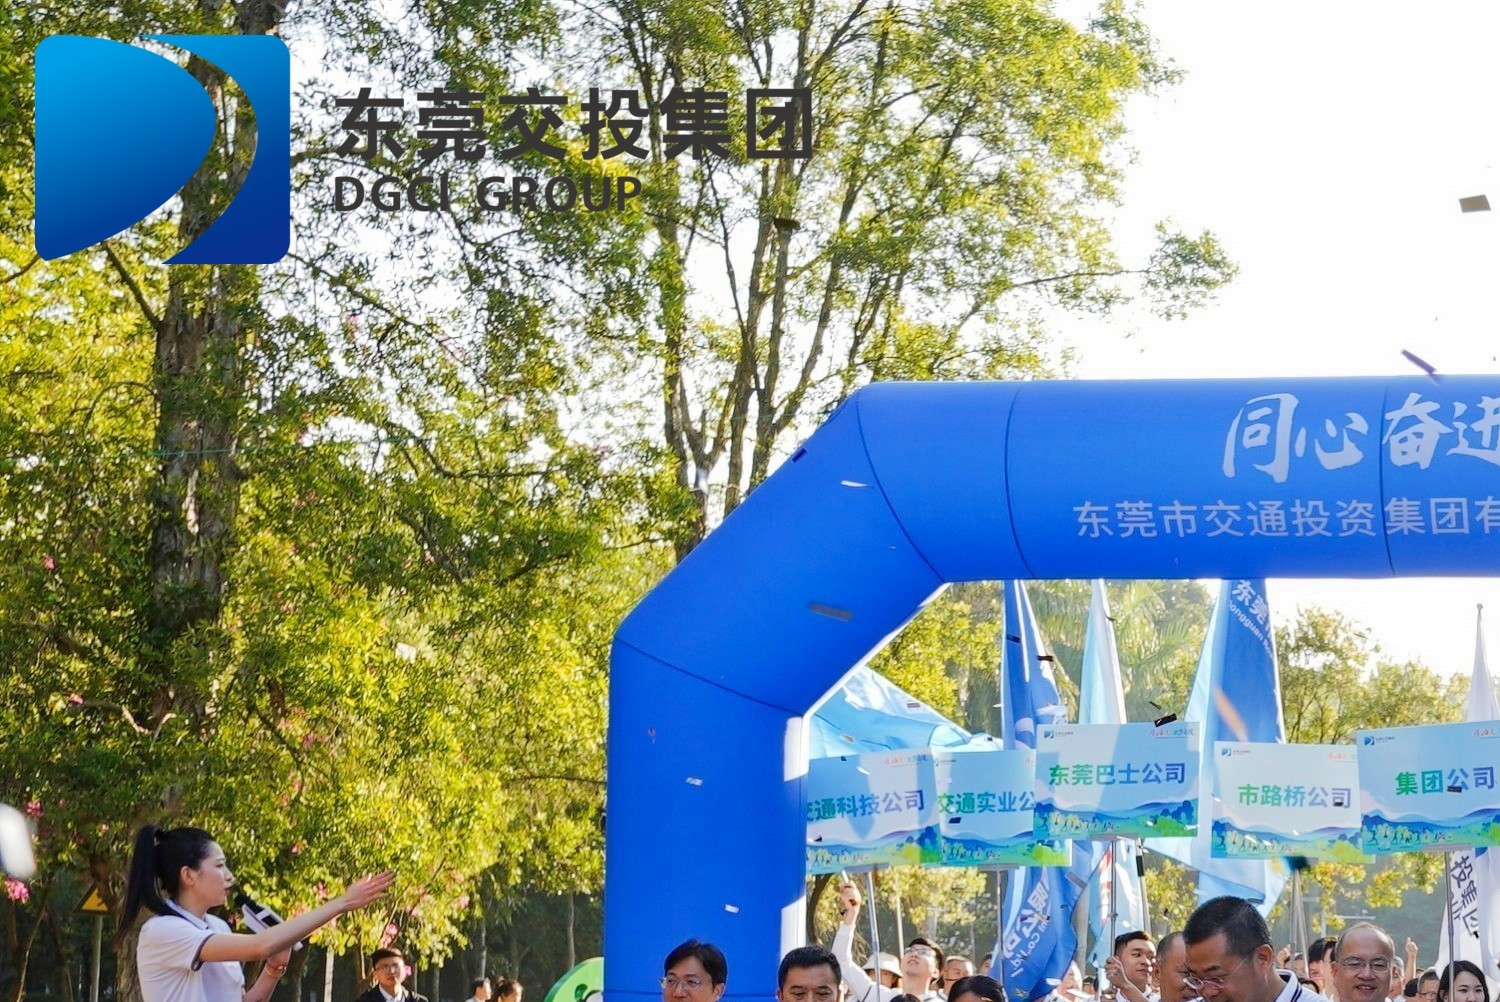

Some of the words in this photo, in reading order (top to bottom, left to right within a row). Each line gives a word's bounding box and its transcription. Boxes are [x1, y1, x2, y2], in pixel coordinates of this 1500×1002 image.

[1229, 600, 1264, 641] ongguan
[1049, 762, 1186, 787] 东莞巴士公司
[1394, 765, 1496, 796] 集团公司
[1238, 783, 1352, 809] 市路桥公司
